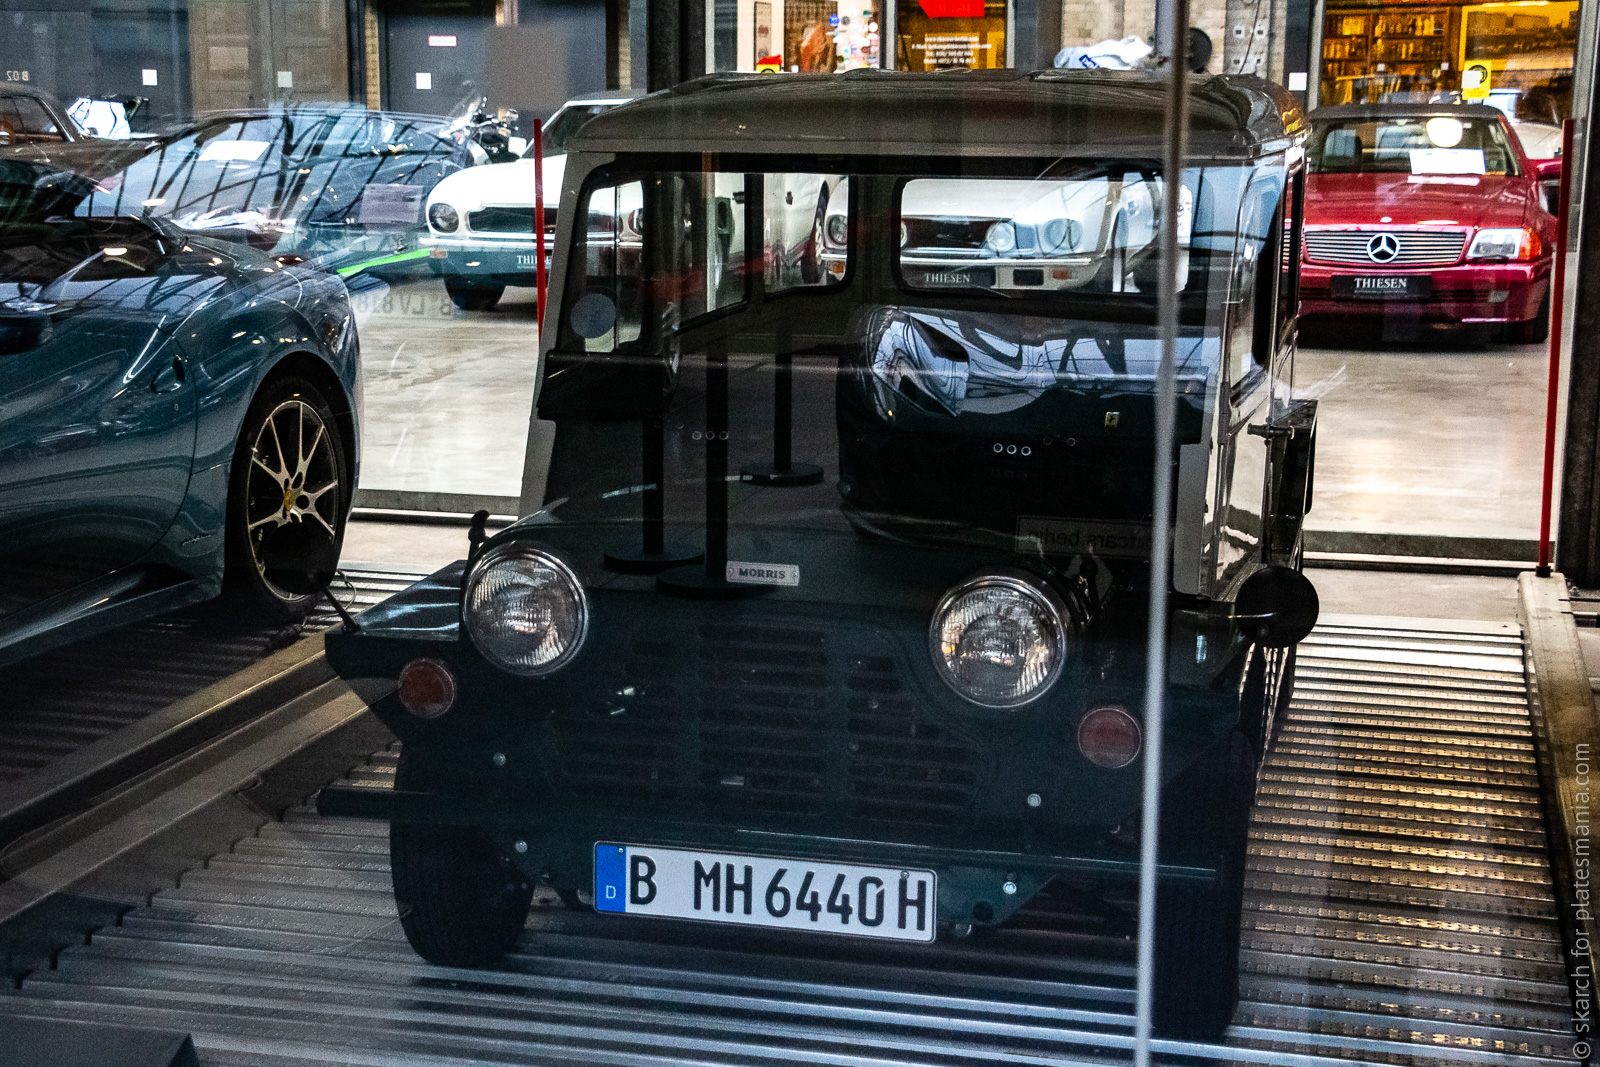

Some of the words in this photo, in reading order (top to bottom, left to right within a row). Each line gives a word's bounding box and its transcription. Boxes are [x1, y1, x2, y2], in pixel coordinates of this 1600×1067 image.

[517, 255, 552, 265] THIE
[924, 273, 971, 284] THIESEN
[1354, 277, 1408, 289] THIESEN
[738, 567, 786, 579] MORRIS
[630, 854, 657, 905] B
[606, 885, 617, 900] D
